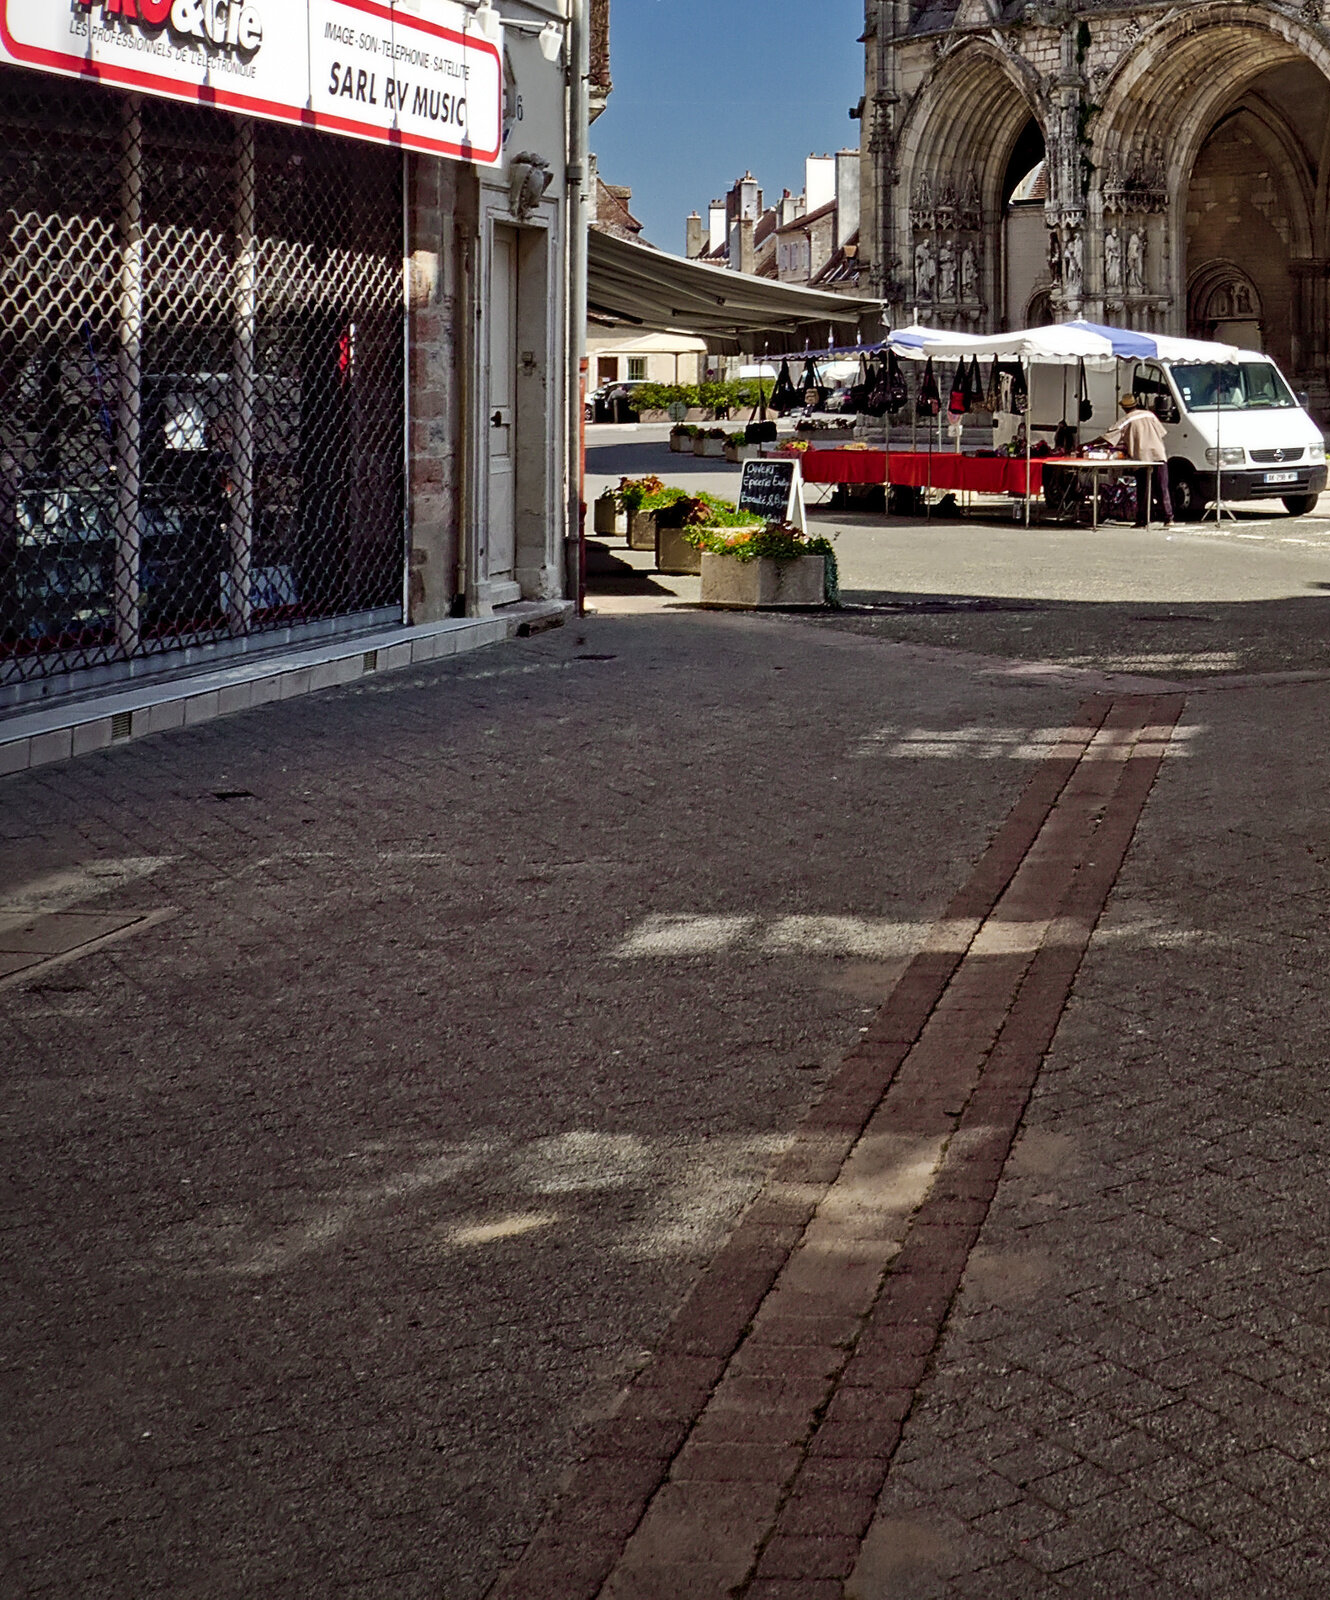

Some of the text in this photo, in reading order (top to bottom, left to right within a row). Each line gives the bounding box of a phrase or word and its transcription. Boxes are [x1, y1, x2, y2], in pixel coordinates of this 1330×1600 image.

[69, 19, 88, 37] LES
[91, 25, 172, 58] PROFESSIONNELS
[175, 49, 187, 63] DE
[328, 61, 467, 127] SARL RV MUSIC
[516, 94, 524, 121] 6
